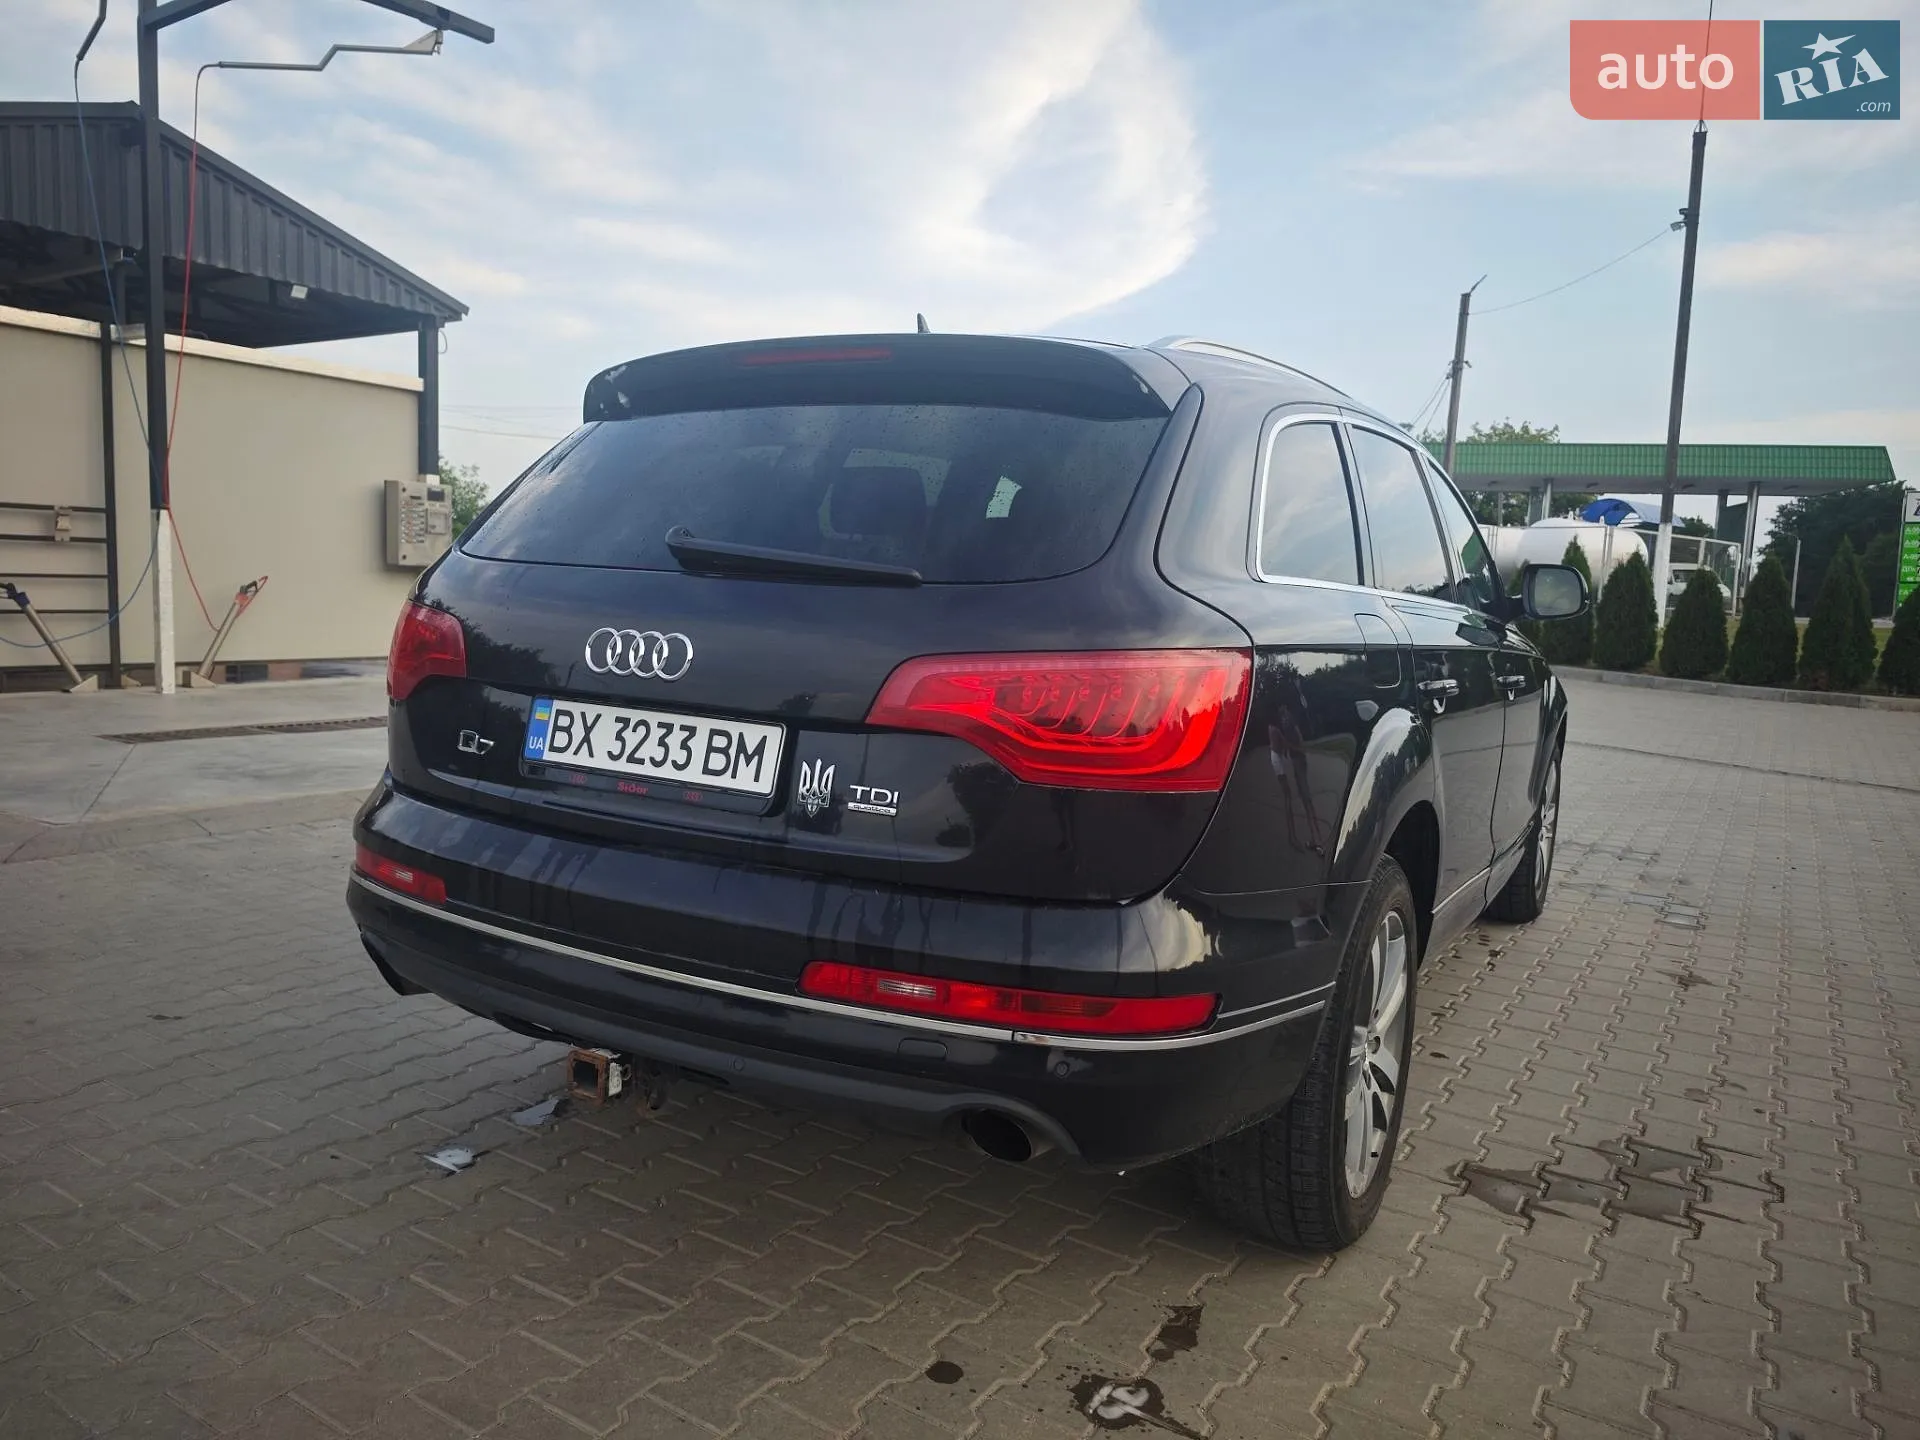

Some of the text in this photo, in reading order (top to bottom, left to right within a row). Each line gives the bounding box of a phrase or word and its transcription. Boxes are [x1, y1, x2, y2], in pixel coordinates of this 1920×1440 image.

[457, 729, 495, 755] Q7
[529, 736, 544, 751] UA
[548, 708, 768, 784] BX 3233 BM
[849, 785, 899, 808] TDI
